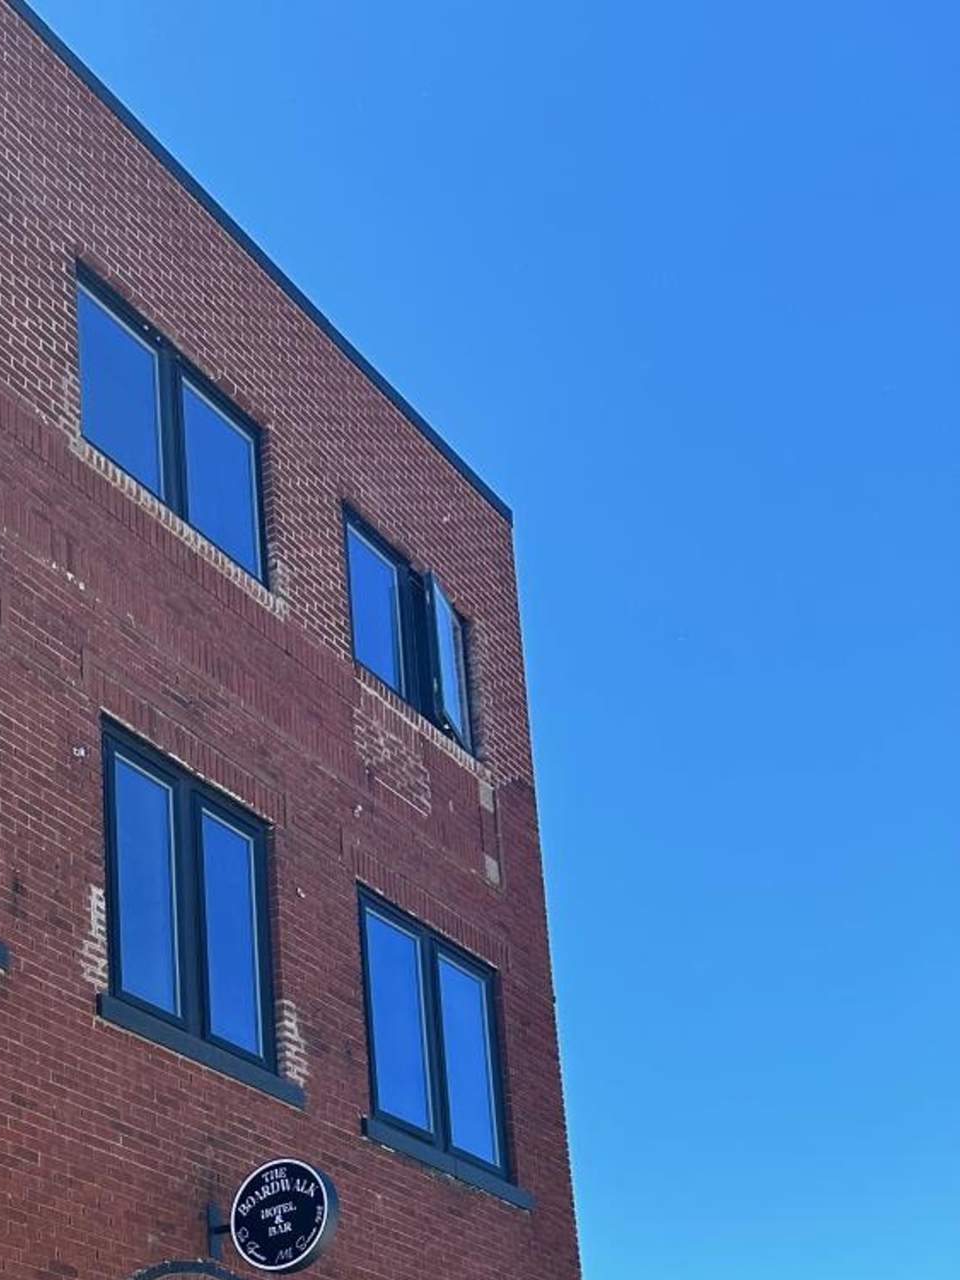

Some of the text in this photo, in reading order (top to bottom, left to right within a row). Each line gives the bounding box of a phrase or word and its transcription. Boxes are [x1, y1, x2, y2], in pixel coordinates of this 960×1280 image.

[261, 1167, 287, 1182] THE
[237, 1178, 318, 1216] BOARDWALK
[261, 1201, 296, 1219] HOTEL
[268, 1221, 292, 1237] BAR
